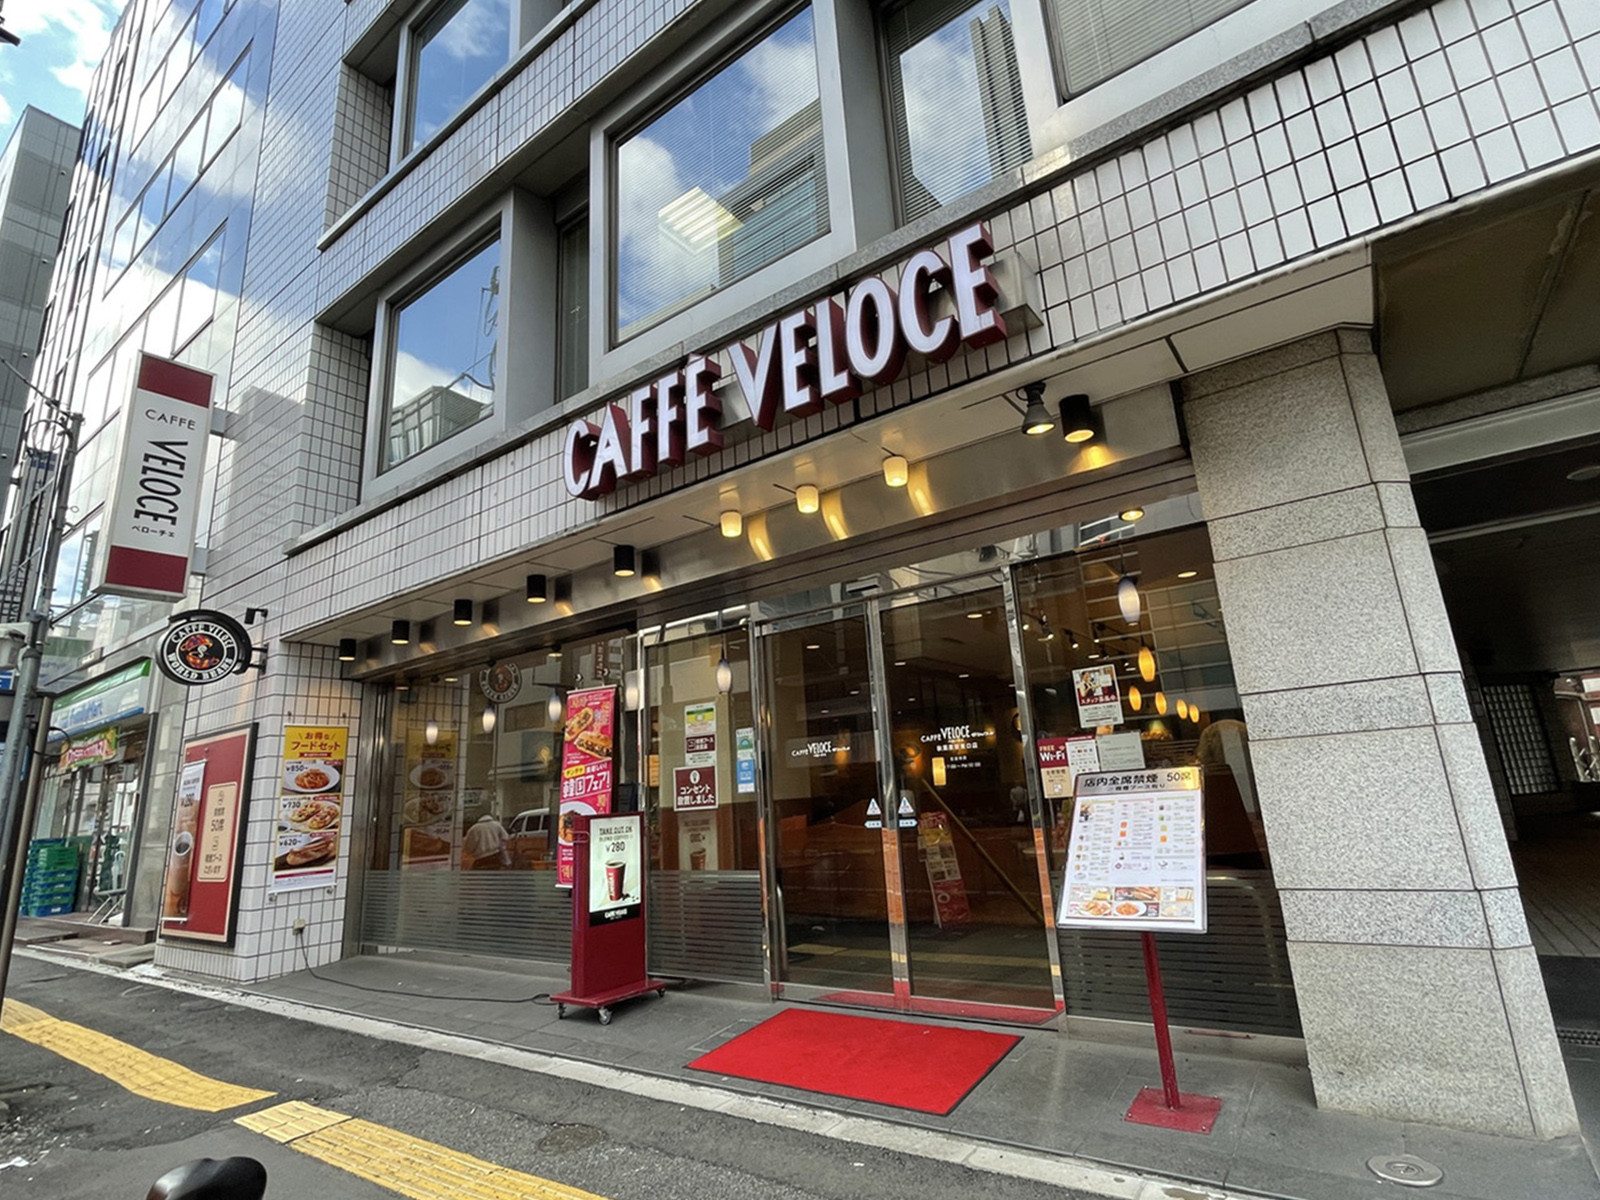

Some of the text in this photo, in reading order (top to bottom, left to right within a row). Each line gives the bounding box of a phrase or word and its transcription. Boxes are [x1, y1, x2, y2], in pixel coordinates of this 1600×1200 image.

[727, 221, 1006, 431] VELOCE
[134, 440, 188, 526] VELOCE
[168, 652, 199, 680] WORLD
[304, 732, 330, 740] お得な
[940, 725, 970, 740] VELOCE
[291, 741, 341, 751] フードセット
[807, 741, 832, 754] VELOCE
[1040, 751, 1066, 762] Wi-Fi
[1084, 773, 1159, 788] 店内全席禁煙
[680, 784, 711, 795] コンセント
